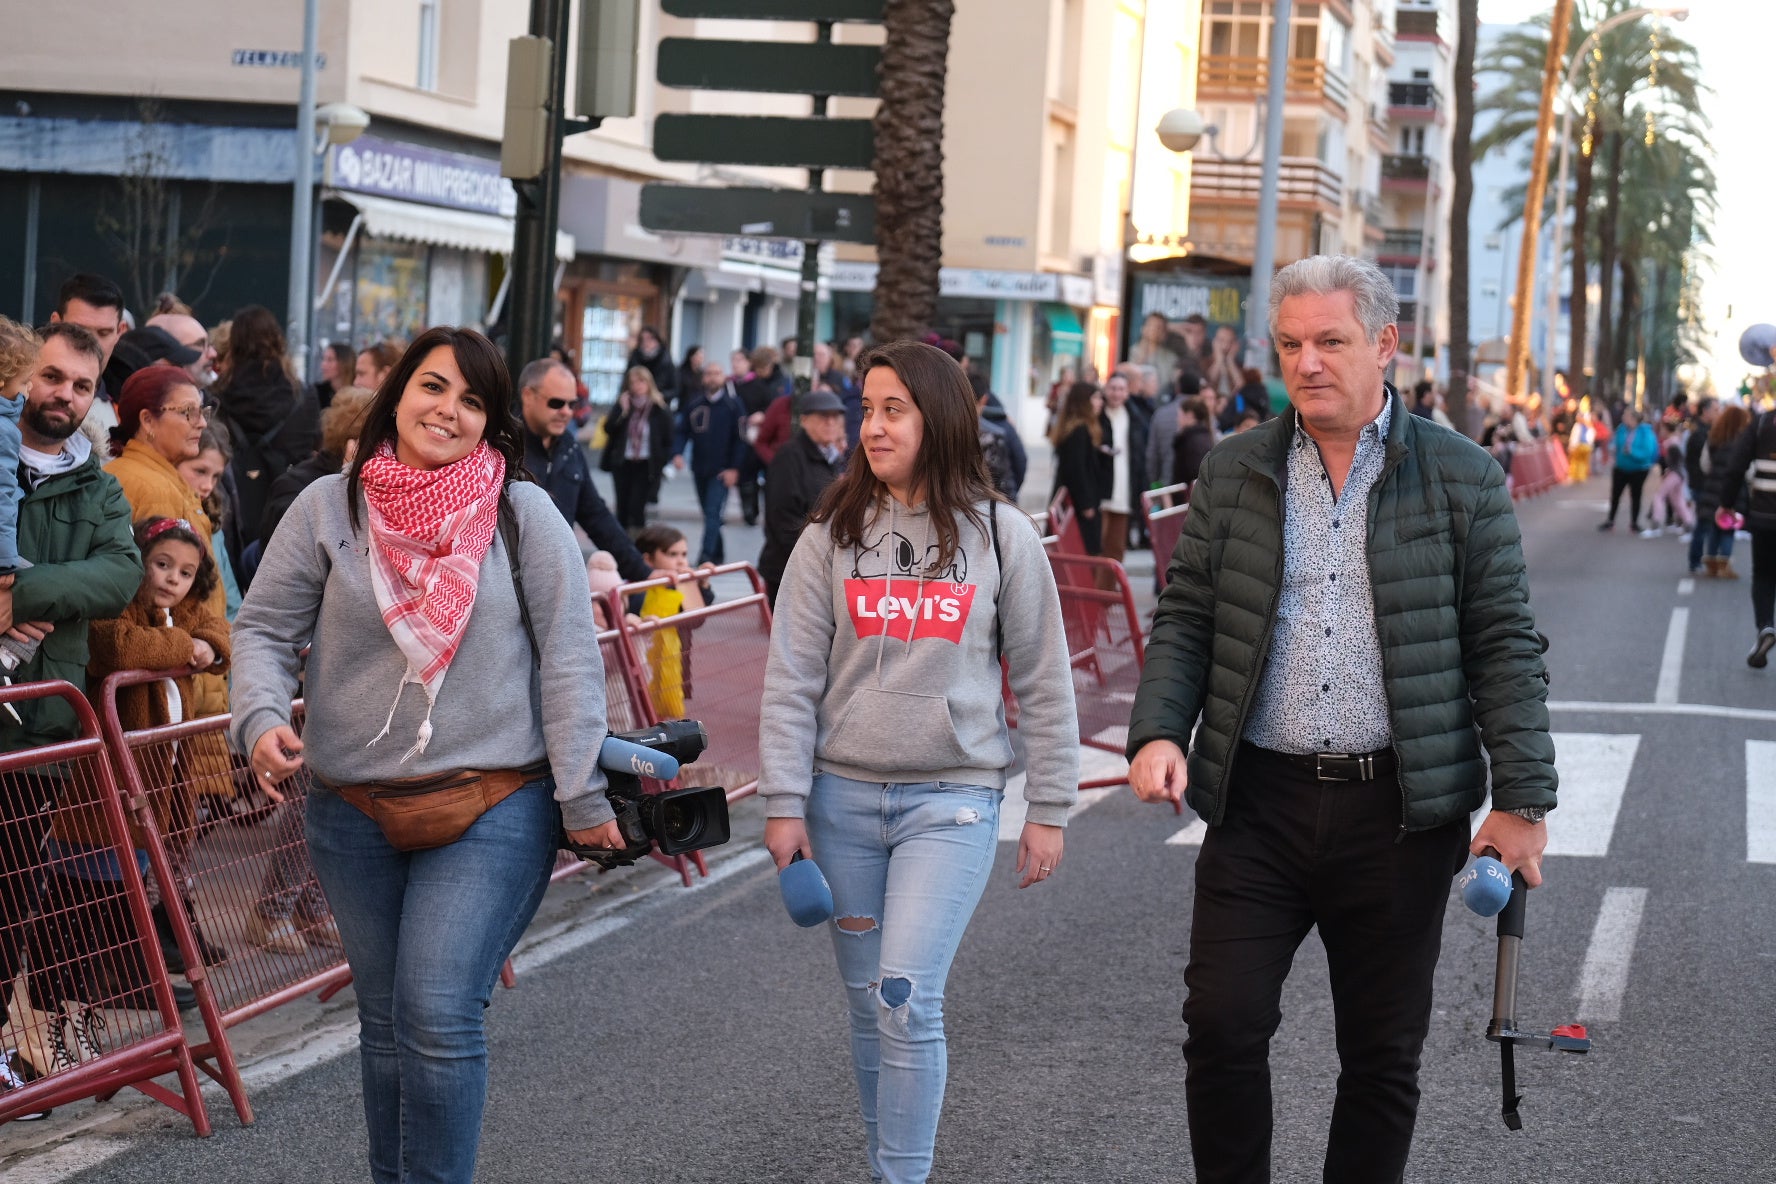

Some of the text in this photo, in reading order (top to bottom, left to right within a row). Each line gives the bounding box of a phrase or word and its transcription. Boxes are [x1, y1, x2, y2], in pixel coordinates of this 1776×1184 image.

[361, 150, 412, 194] BAZAR
[631, 753, 657, 779] tve
[1487, 865, 1509, 888] tve
